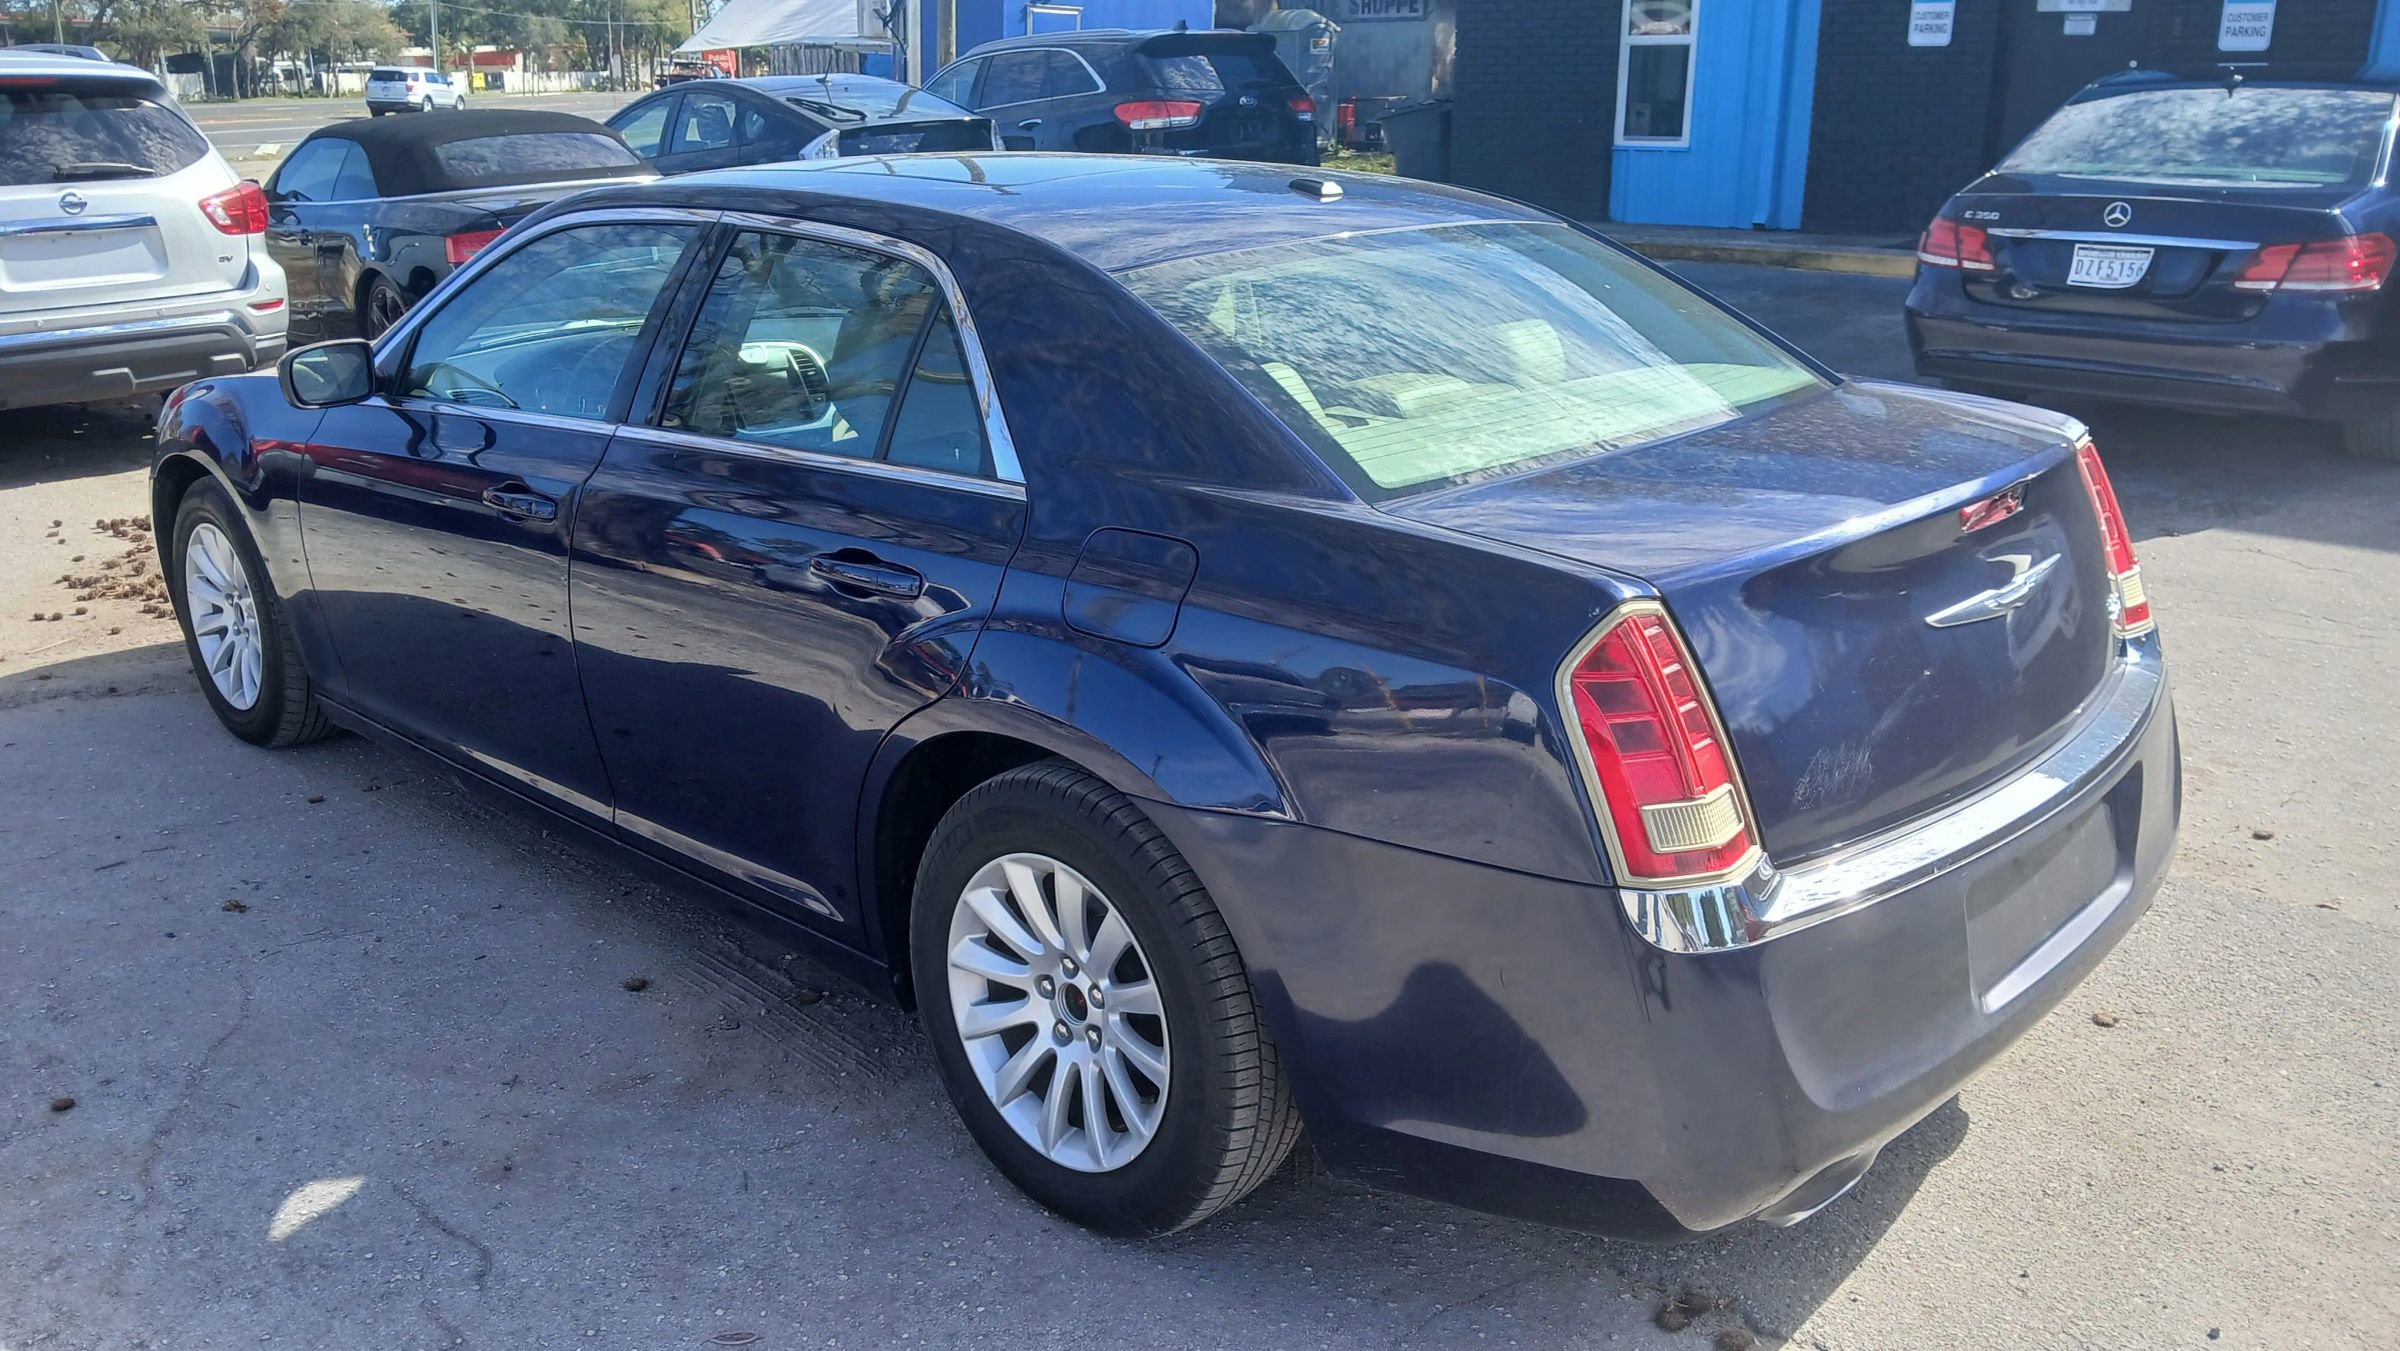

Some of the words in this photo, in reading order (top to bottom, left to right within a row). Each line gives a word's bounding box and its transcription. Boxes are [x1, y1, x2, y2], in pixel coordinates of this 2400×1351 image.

[2226, 12, 2269, 22] CUSTOMER
[2225, 26, 2266, 37] PARKING
[2075, 259, 2145, 277] DZF5156
